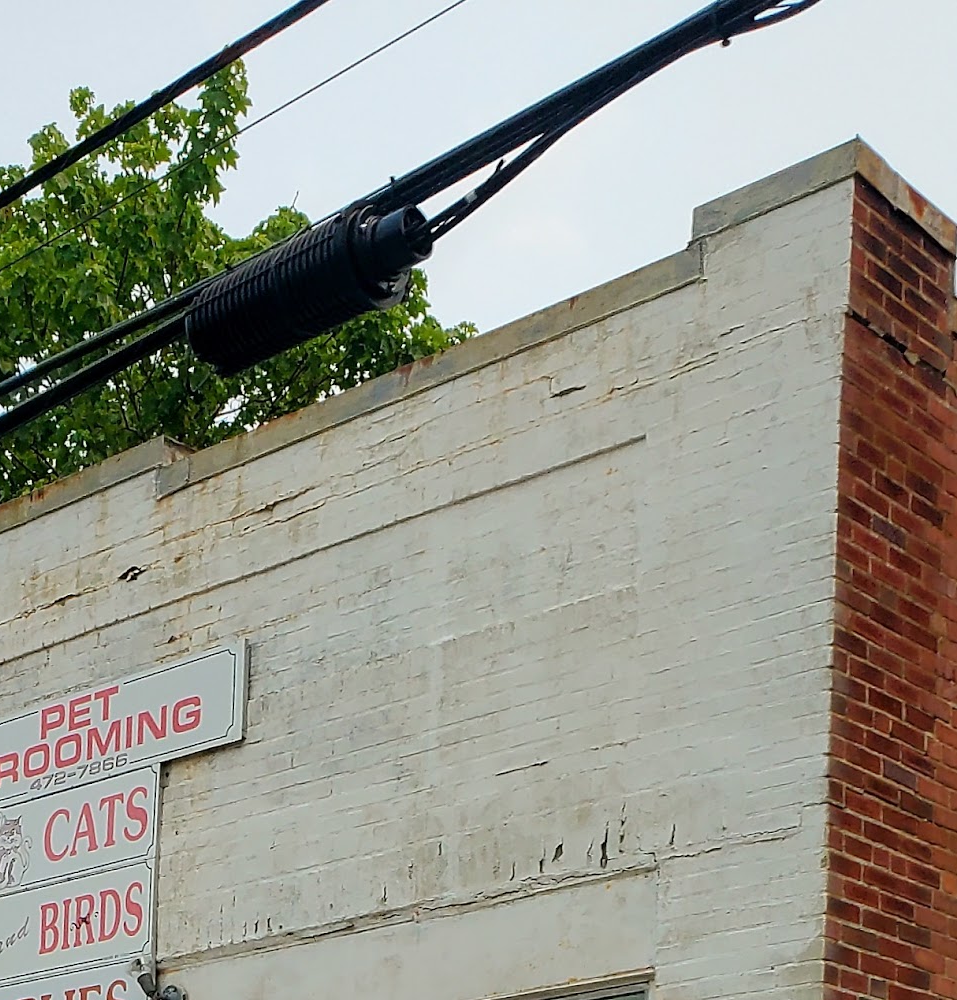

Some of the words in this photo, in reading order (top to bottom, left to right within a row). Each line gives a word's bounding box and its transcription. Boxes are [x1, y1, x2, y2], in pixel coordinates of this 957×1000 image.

[40, 685, 119, 740] PET
[29, 753, 128, 791] 472-7866
[44, 787, 149, 862] CATS
[38, 881, 143, 955] BIRDS
